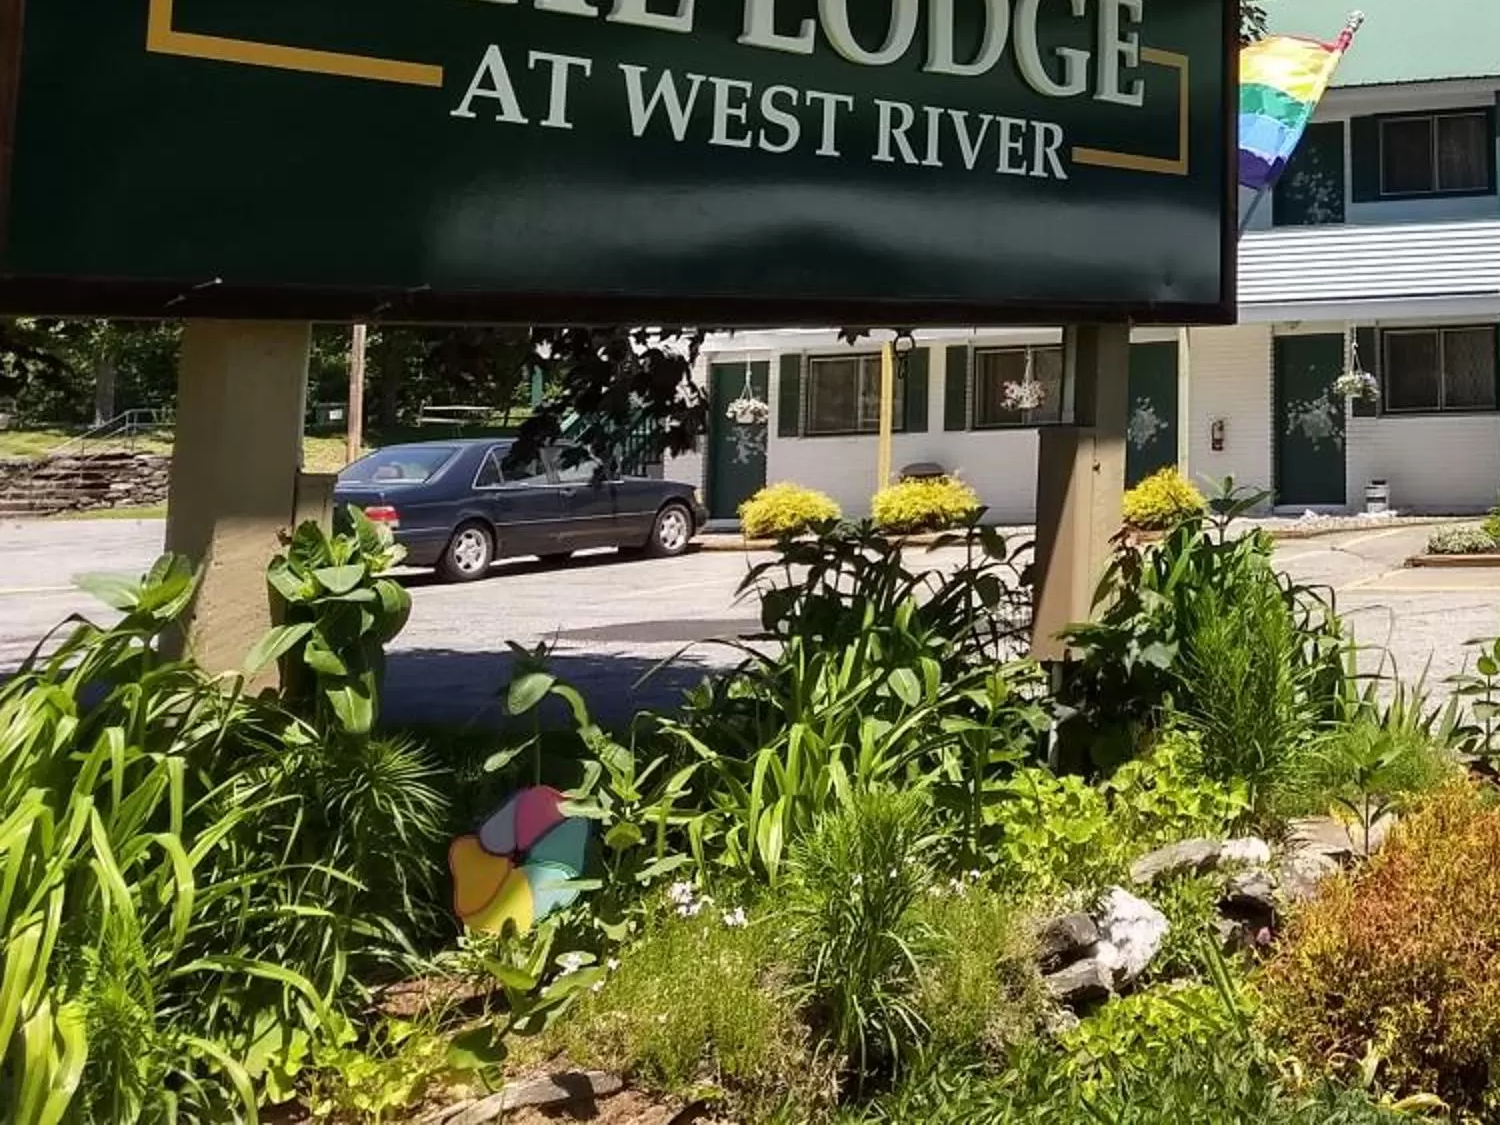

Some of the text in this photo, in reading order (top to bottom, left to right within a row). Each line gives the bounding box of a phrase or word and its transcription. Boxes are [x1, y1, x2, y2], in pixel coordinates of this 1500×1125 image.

[450, 42, 1069, 180] AT WEST RIVER
